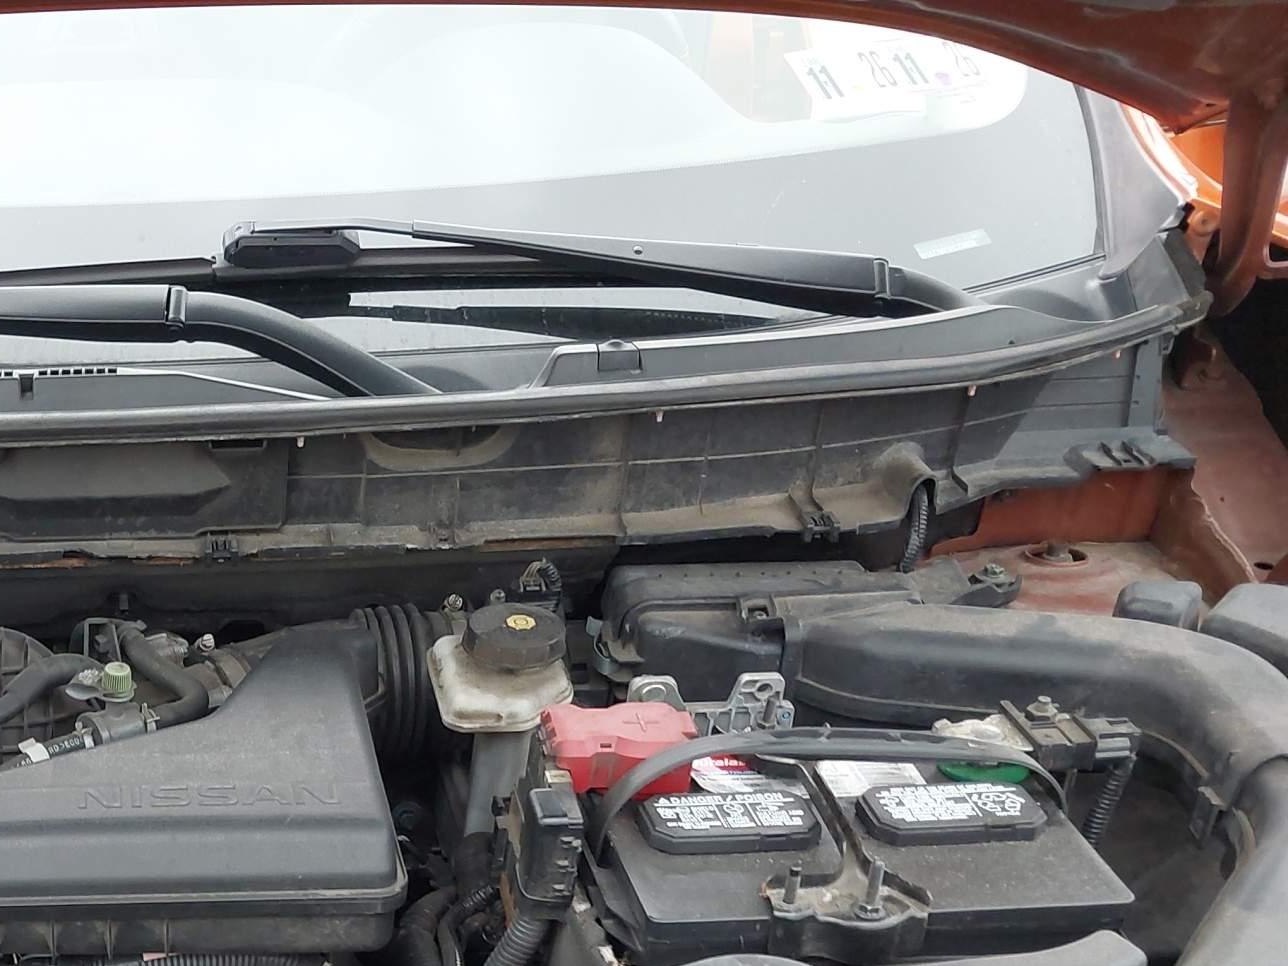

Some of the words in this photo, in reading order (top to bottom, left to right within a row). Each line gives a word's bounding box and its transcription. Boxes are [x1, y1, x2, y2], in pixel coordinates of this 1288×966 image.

[806, 64, 845, 100] 11
[857, 50, 899, 89] 26
[891, 51, 930, 86] 11
[77, 782, 342, 810] NISSAN
[669, 795, 724, 806] DANGER
[735, 791, 784, 802] POISON
